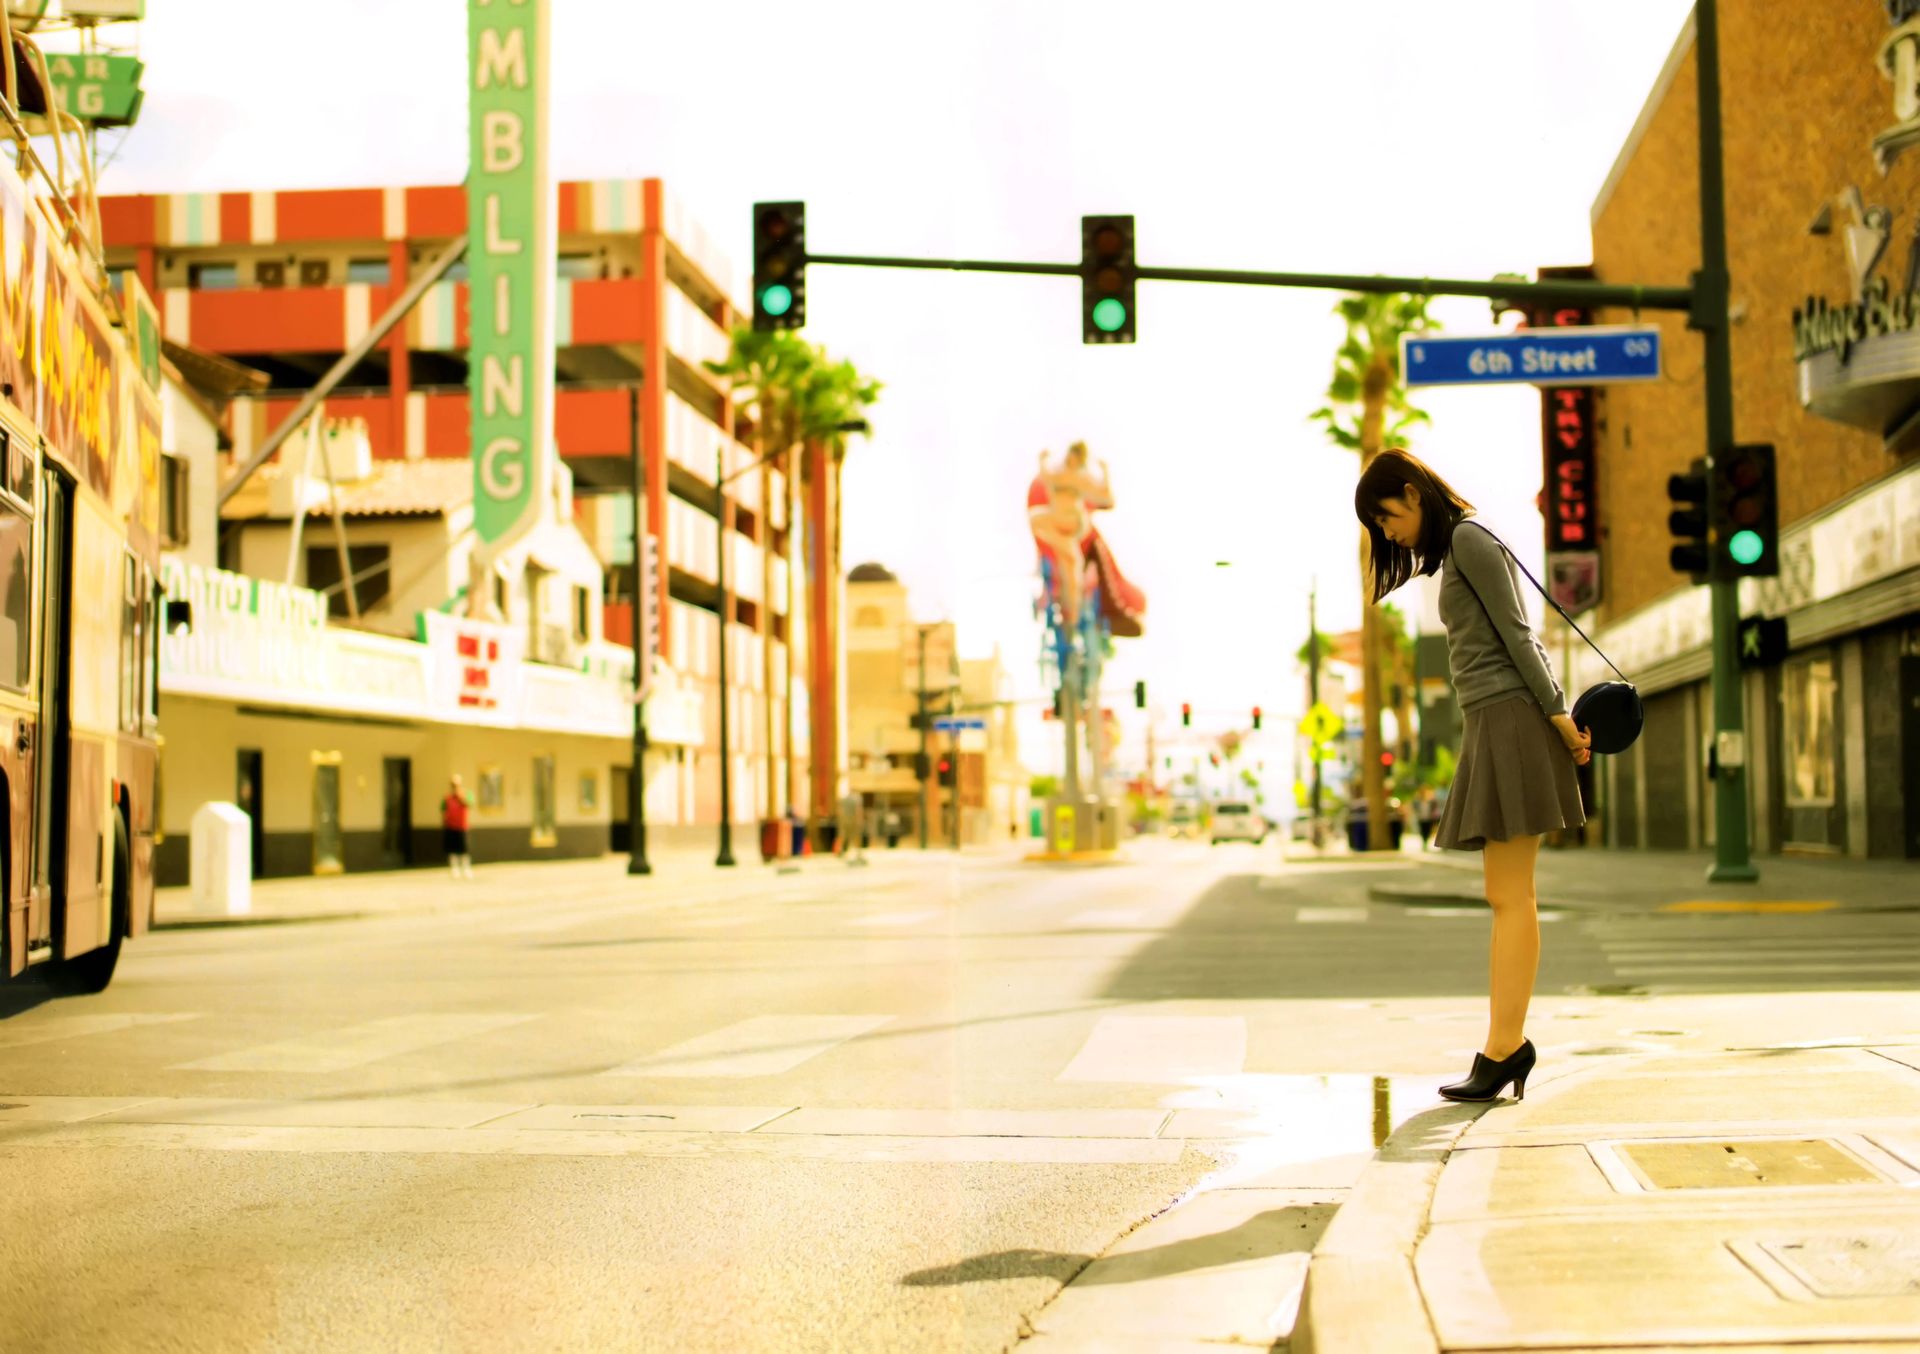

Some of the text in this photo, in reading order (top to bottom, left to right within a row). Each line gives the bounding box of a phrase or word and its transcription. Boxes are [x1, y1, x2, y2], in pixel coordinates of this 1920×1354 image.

[473, 0, 528, 500] MBLING
[1468, 345, 1597, 374] 6th Street
[1558, 459, 1586, 541] CLUB
